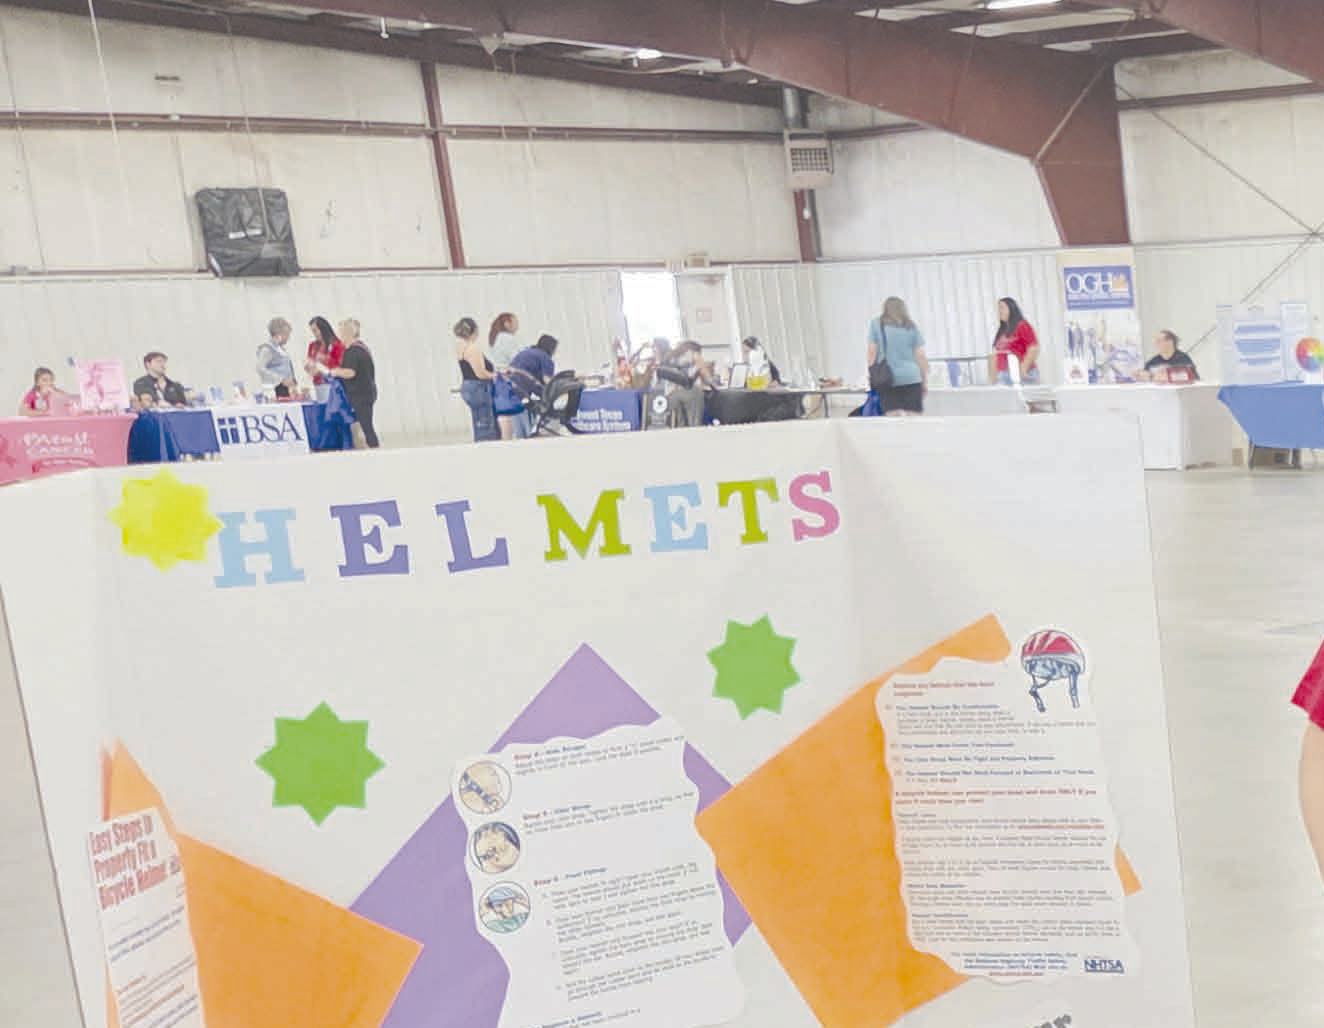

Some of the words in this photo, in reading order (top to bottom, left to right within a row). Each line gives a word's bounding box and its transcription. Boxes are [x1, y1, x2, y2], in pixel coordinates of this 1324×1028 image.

[1066, 271, 1112, 295] OGH
[243, 412, 304, 445] BSA
[213, 470, 842, 589] HELMETS
